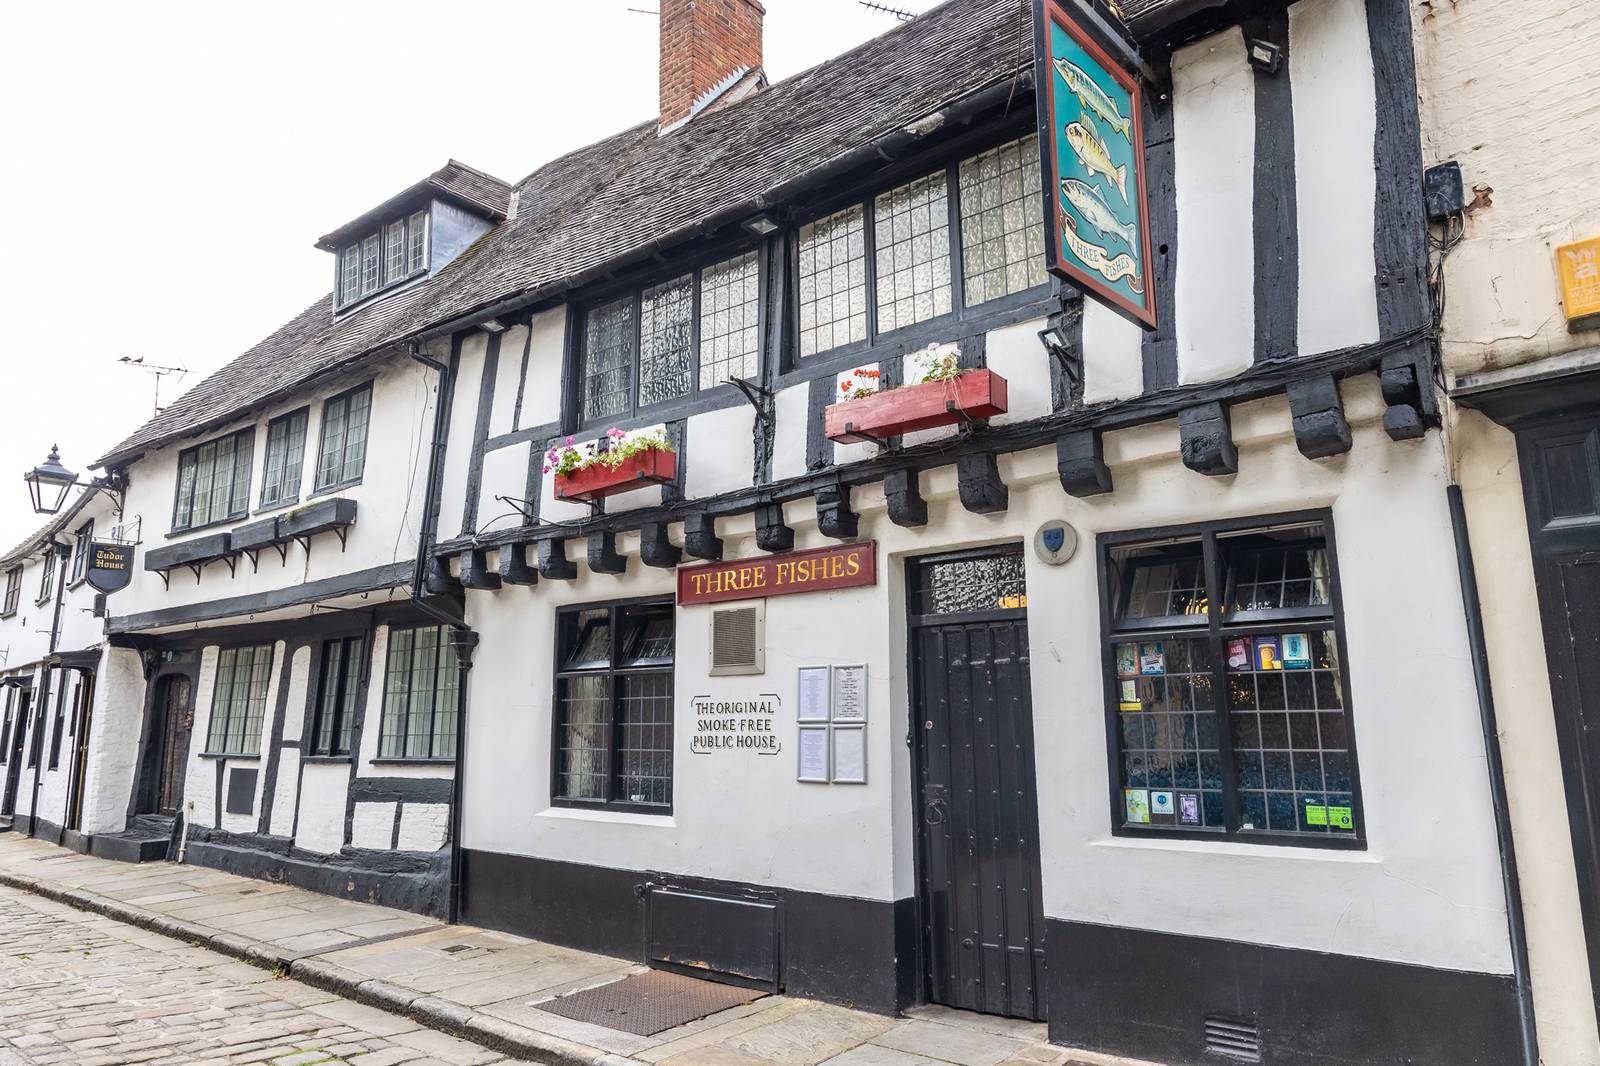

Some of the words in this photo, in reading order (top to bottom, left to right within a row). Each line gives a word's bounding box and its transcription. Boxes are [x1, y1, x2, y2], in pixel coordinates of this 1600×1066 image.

[1071, 237, 1099, 262] THREE
[1105, 257, 1130, 276] FISHES
[96, 550, 124, 560] Tudor
[95, 559, 125, 569] House
[691, 566, 766, 595] THREE
[776, 552, 861, 585] FISHES
[693, 735, 734, 749] PUBLIC
[736, 735, 776, 749] HOUSE
